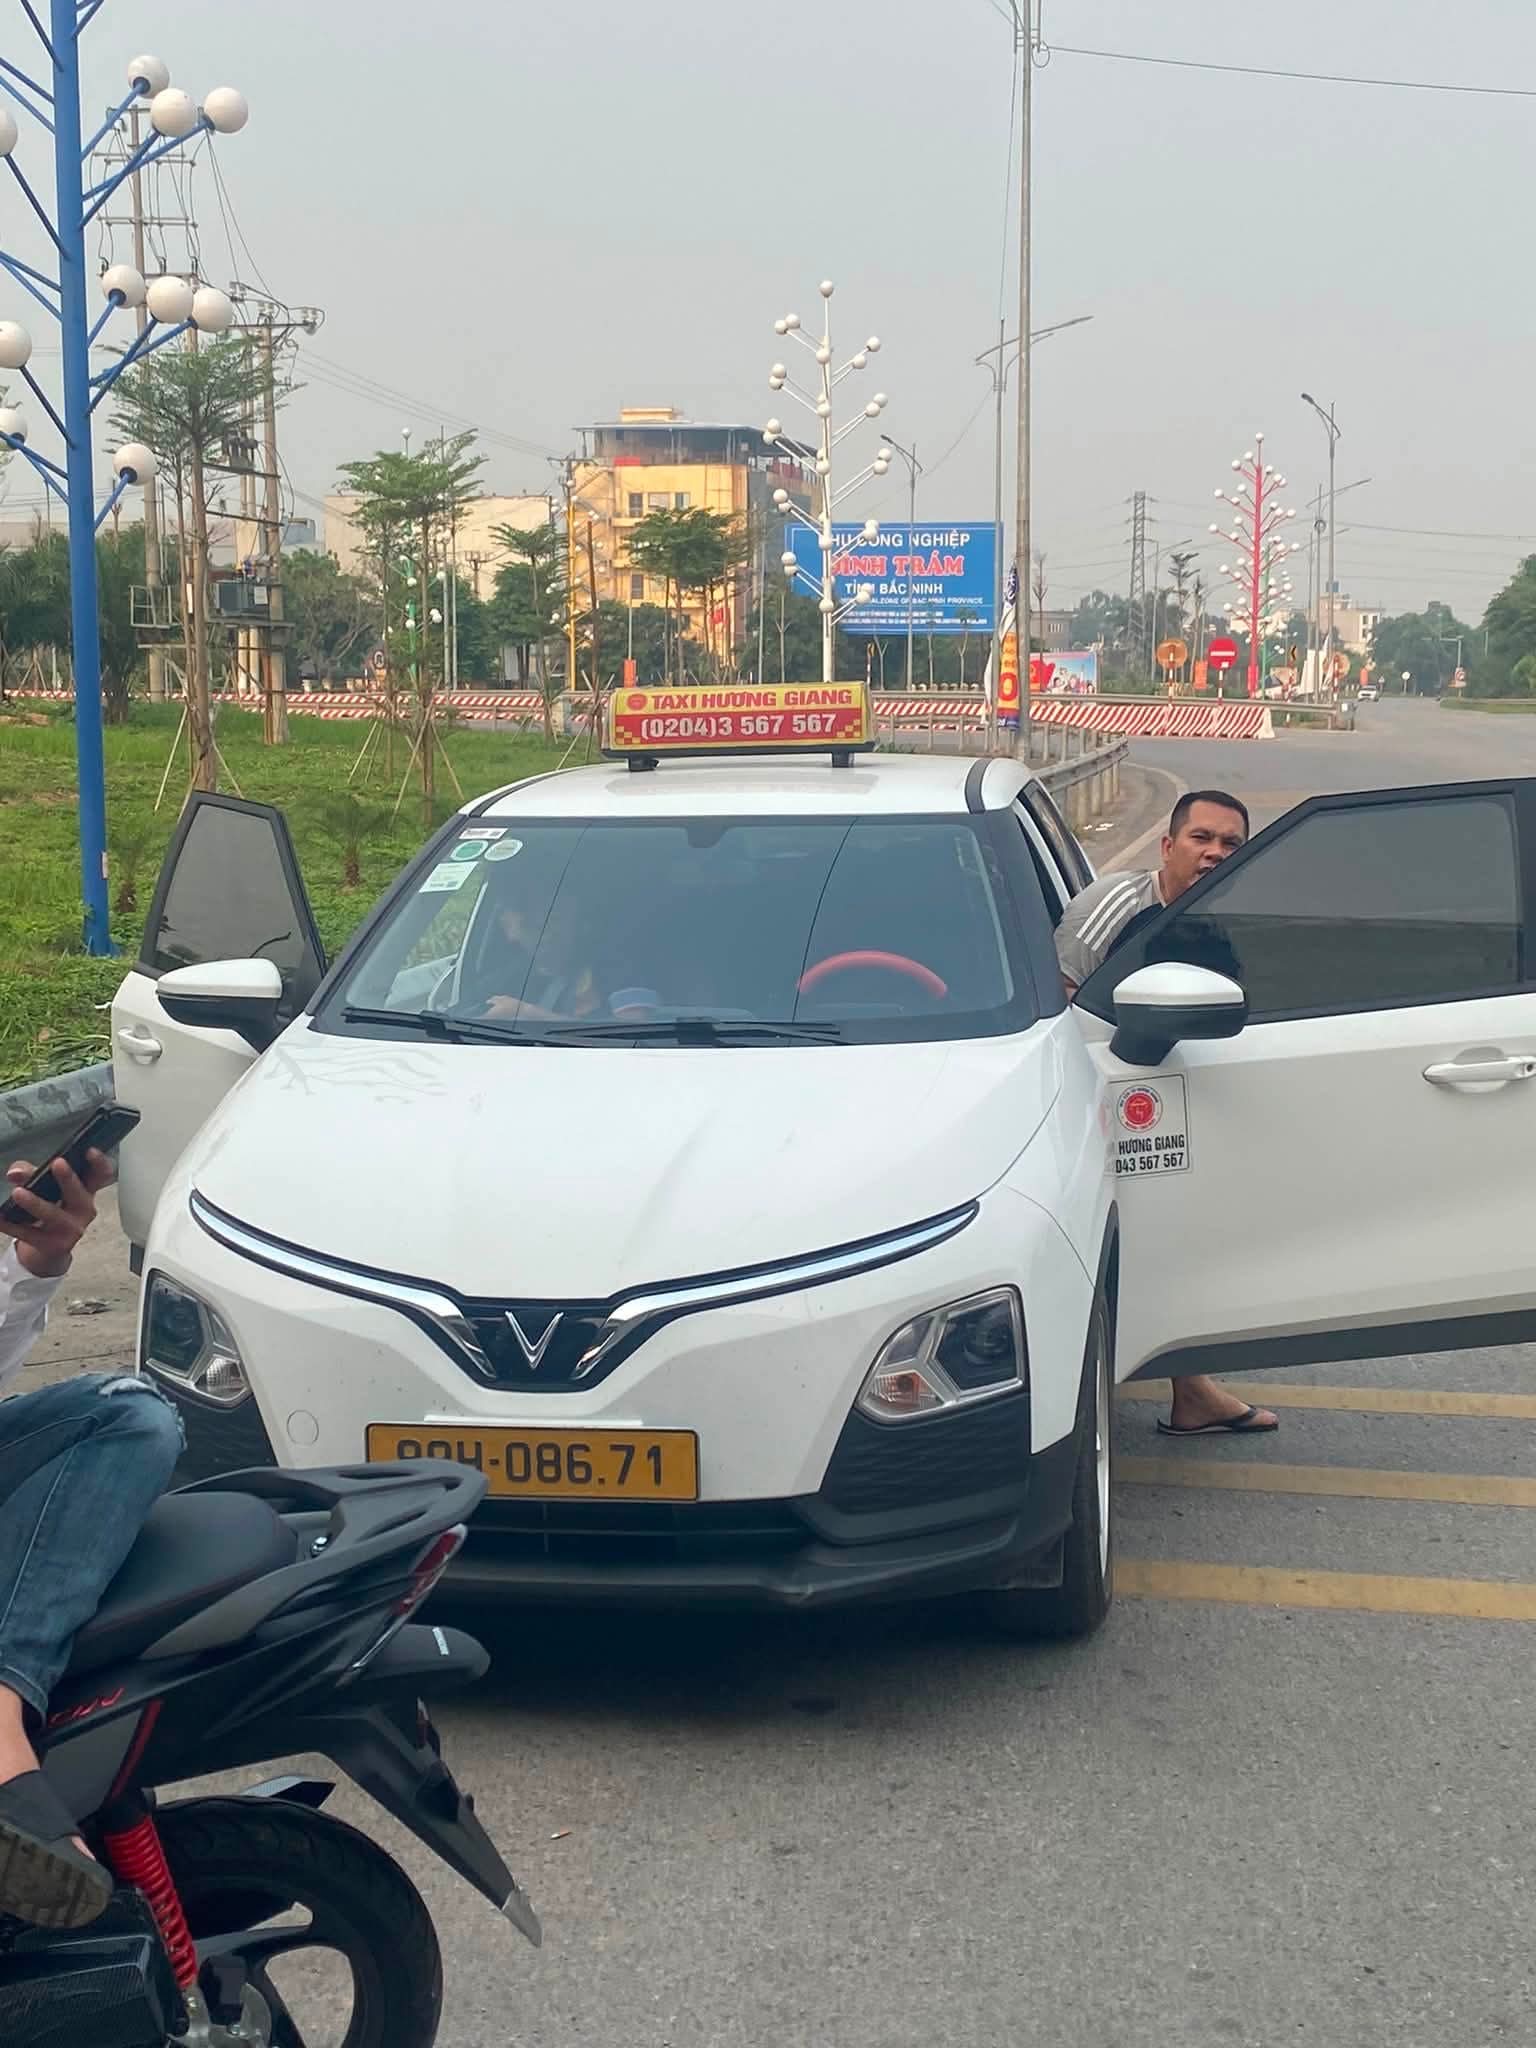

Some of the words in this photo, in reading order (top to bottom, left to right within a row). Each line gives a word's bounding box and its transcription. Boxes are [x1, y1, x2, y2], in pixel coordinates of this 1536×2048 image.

[820, 534, 852, 547] HU
[909, 529, 970, 549] NGHIỆP
[911, 583, 943, 595] NINH
[652, 693, 697, 710] TAXI
[784, 689, 852, 706] GIANG
[641, 715, 732, 739] (0204)3
[740, 714, 784, 735] 567
[792, 713, 836, 733] 567
[1119, 1138, 1152, 1155] HƯƠNG
[1154, 1134, 1185, 1151] GIANG
[1139, 1155, 1160, 1170] 567
[1163, 1152, 1184, 1168] 567
